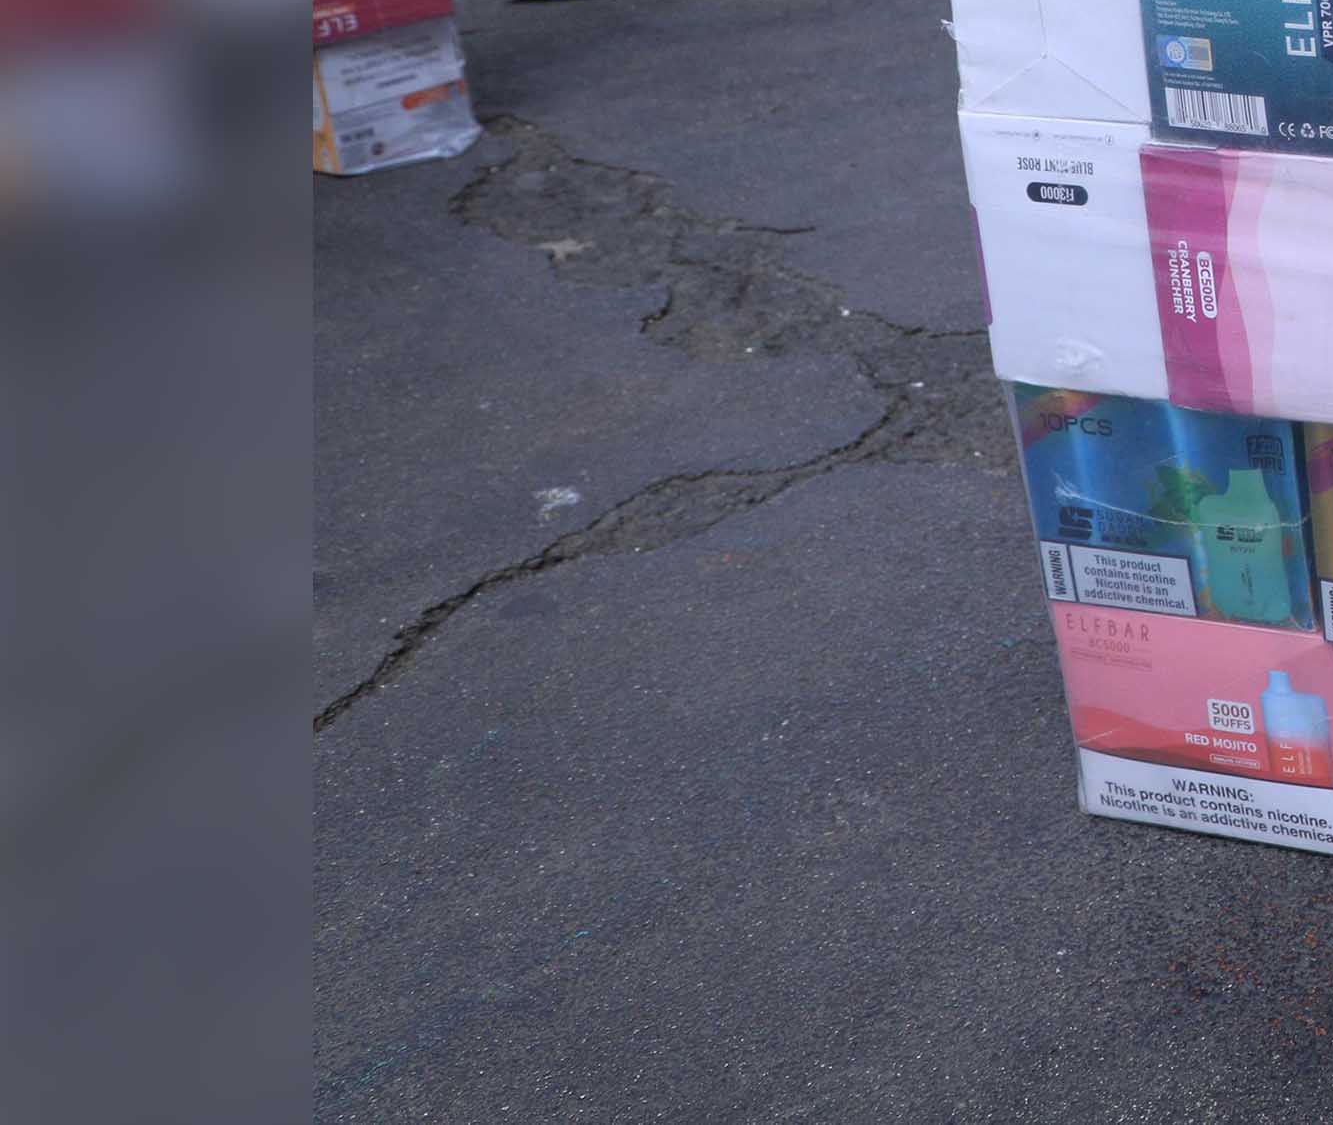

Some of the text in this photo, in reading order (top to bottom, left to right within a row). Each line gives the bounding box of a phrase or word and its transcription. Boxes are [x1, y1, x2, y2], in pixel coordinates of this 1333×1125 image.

[1017, 156, 1041, 171] ROSE
[1168, 249, 1185, 315] PUNCHER
[1178, 240, 1197, 323] CRANBERRY
[1199, 257, 1215, 313] BC5000
[1041, 413, 1113, 436] 10PCS
[1211, 702, 1250, 720] 5000
[1213, 716, 1252, 731] PUFFS
[1185, 732, 1257, 753] RED MOJITO
[1172, 778, 1254, 802] WARNING:
[1099, 795, 1160, 815] Nicotine
[1162, 805, 1177, 818] is
[1179, 809, 1198, 821] an
[1201, 809, 1268, 832] addictive
[1105, 780, 1332, 830] This product contains nicotine.
